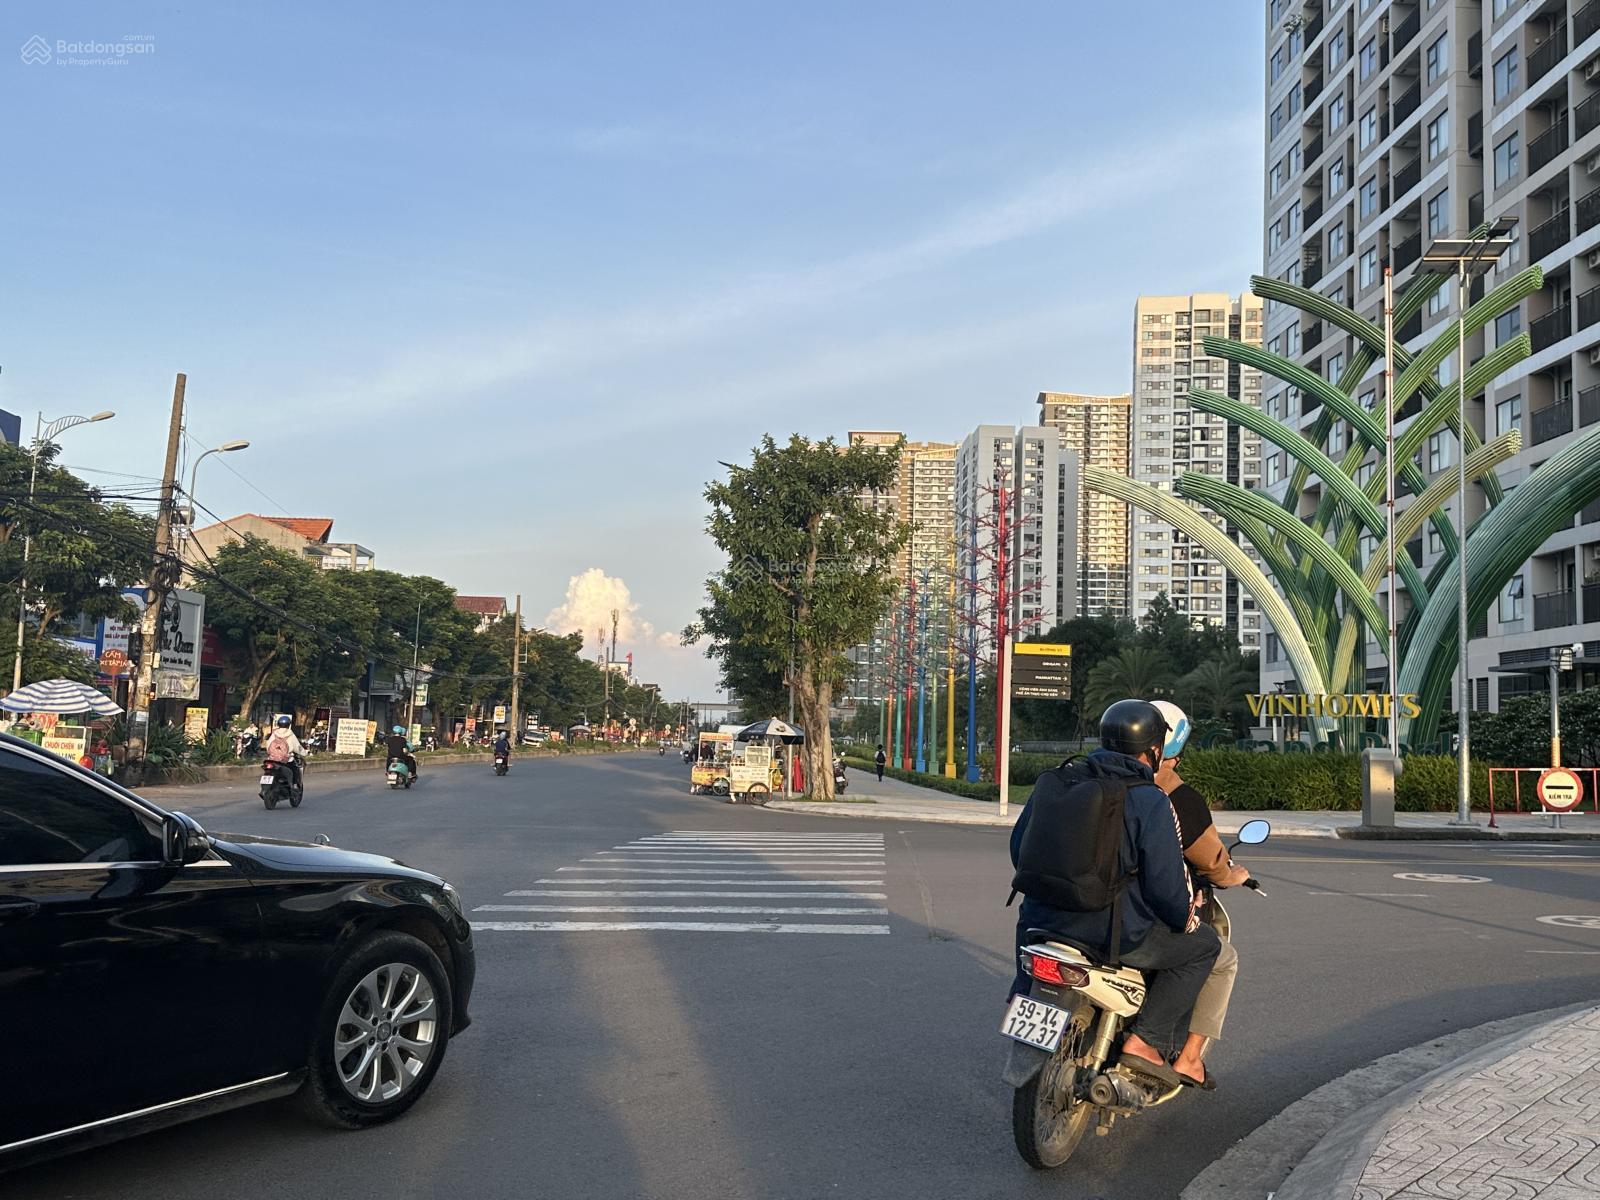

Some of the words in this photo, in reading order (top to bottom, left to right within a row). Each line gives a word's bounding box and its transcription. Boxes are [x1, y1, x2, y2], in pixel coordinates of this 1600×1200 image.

[1245, 693, 1422, 719] VINHOMES
[1017, 999, 1059, 1027] 59-X4
[1008, 1017, 1057, 1046] 127.37
